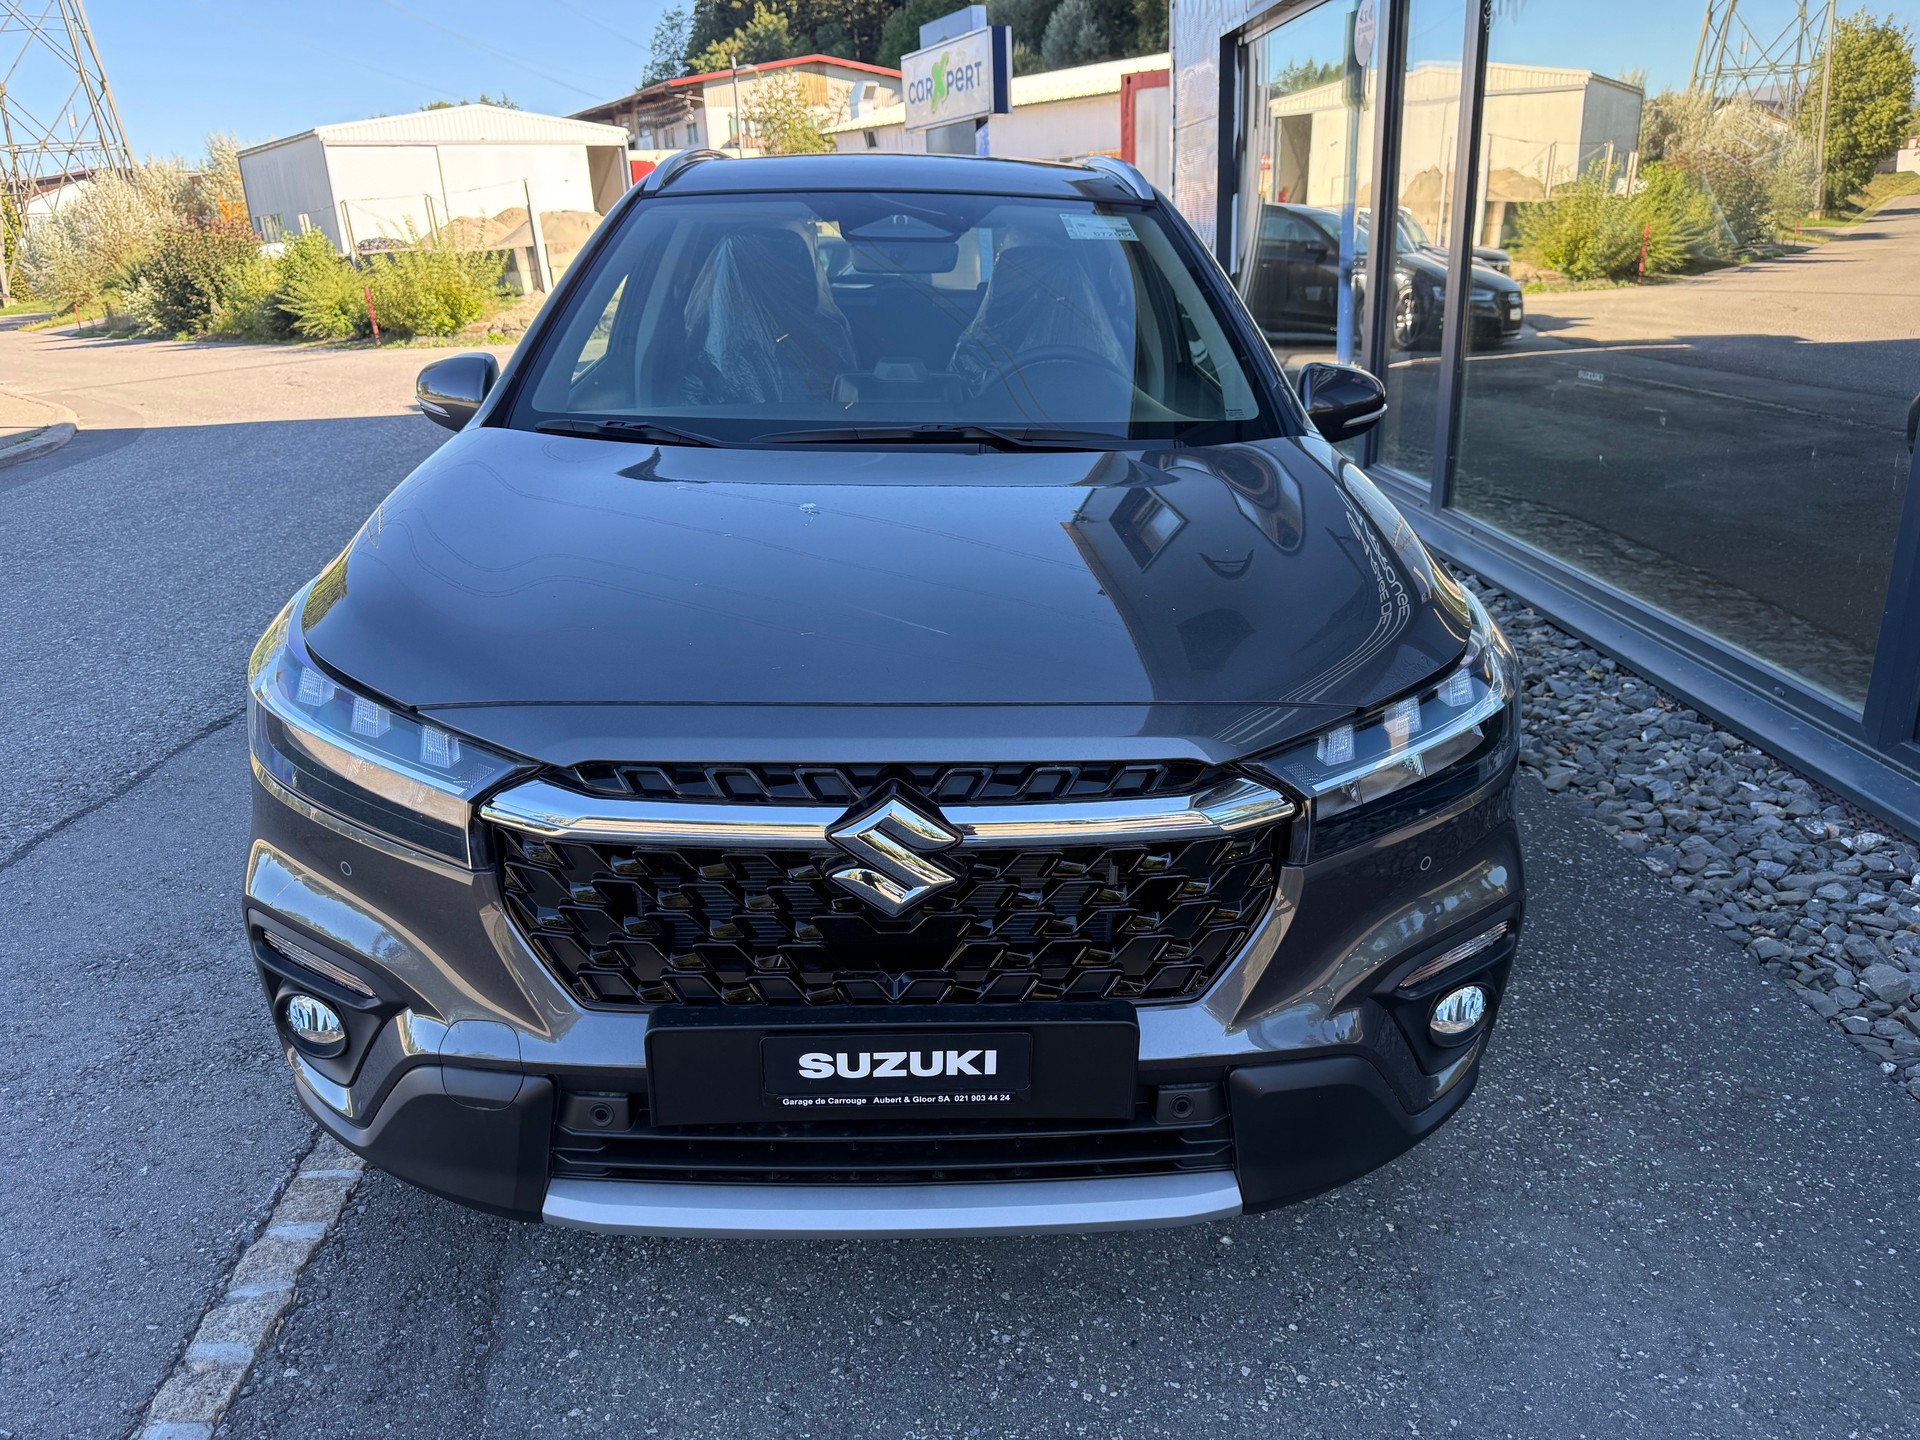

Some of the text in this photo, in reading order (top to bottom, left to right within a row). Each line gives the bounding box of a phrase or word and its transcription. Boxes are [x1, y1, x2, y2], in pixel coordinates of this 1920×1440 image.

[798, 1050, 997, 1079] SUZUKI
[782, 1098, 813, 1106] Garage
[827, 1097, 867, 1105] Carrouge
[873, 1096, 902, 1104] Aubert
[971, 1094, 986, 1102] 903
